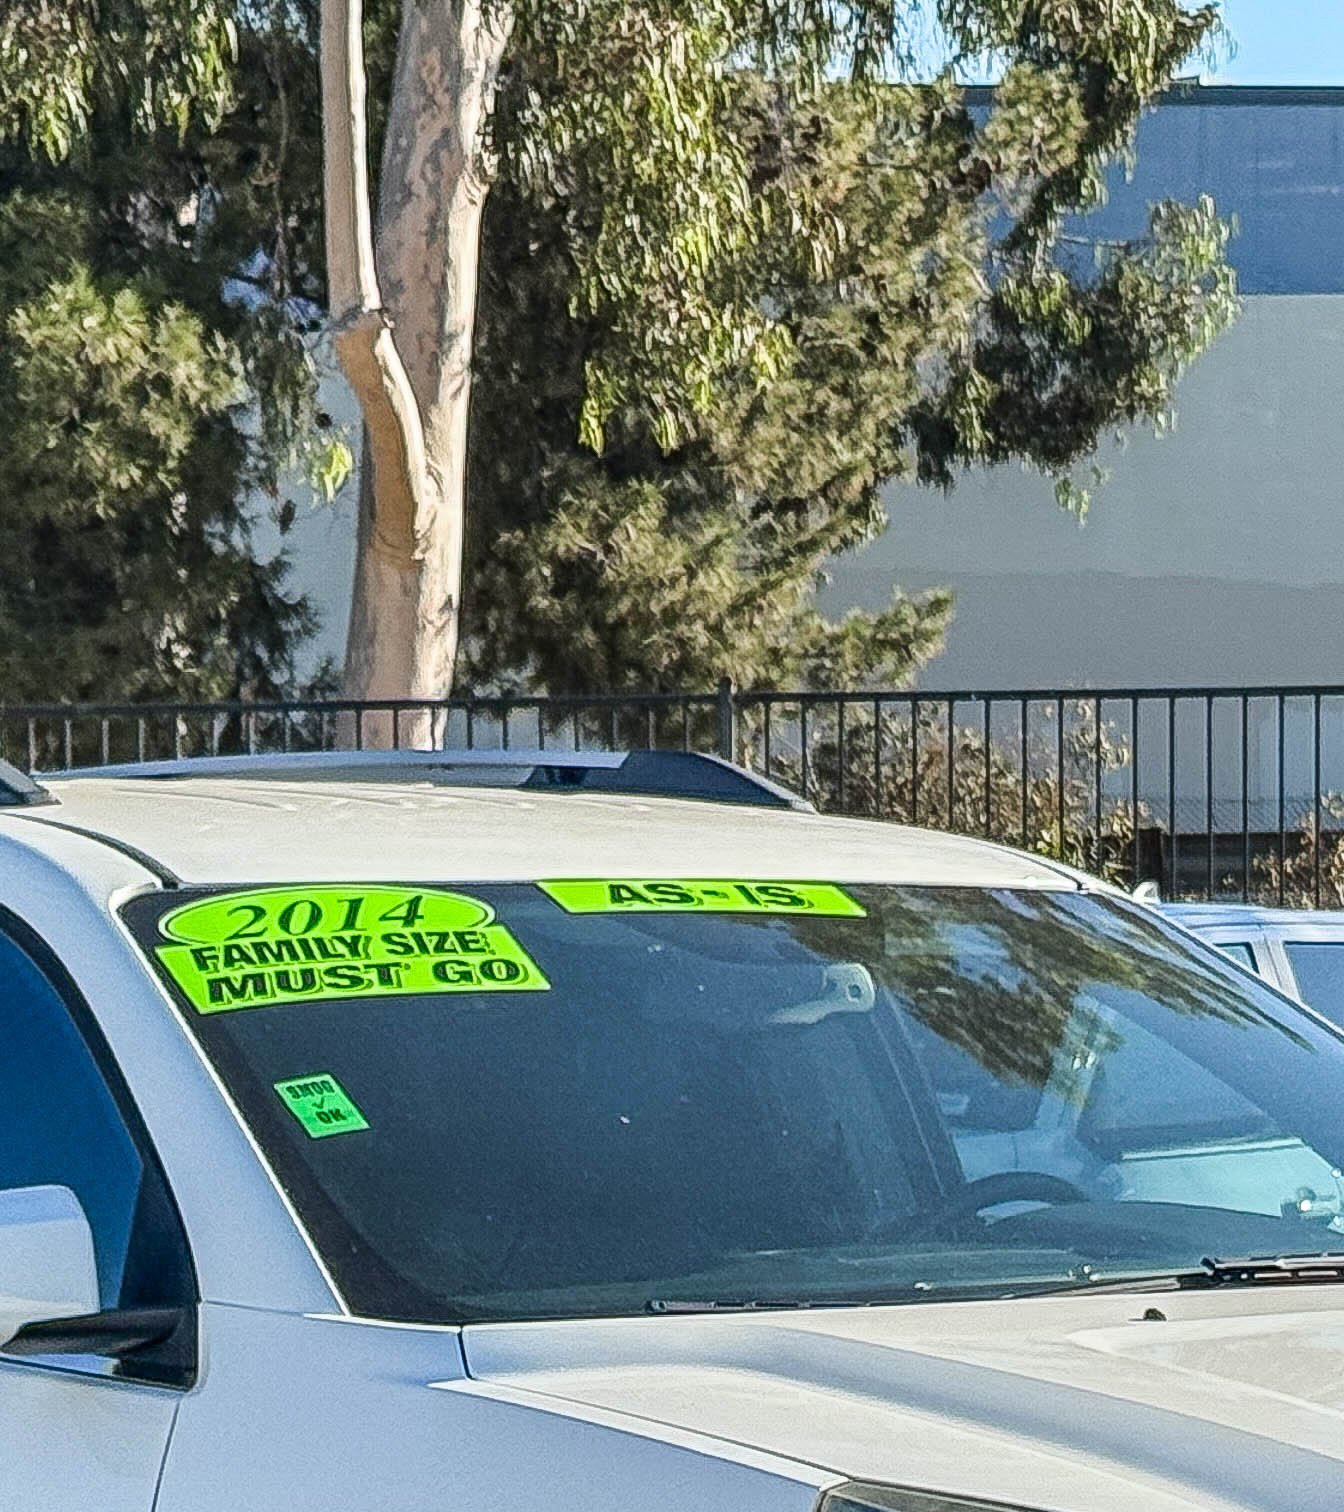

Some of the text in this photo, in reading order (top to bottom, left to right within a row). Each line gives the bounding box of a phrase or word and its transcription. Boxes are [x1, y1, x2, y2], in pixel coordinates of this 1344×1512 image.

[609, 883, 810, 909] AS-IS
[227, 896, 424, 939] 2014
[191, 931, 489, 973] FAMILY SIZE
[207, 958, 529, 1005] MUST GO
[315, 1108, 347, 1124] OK
